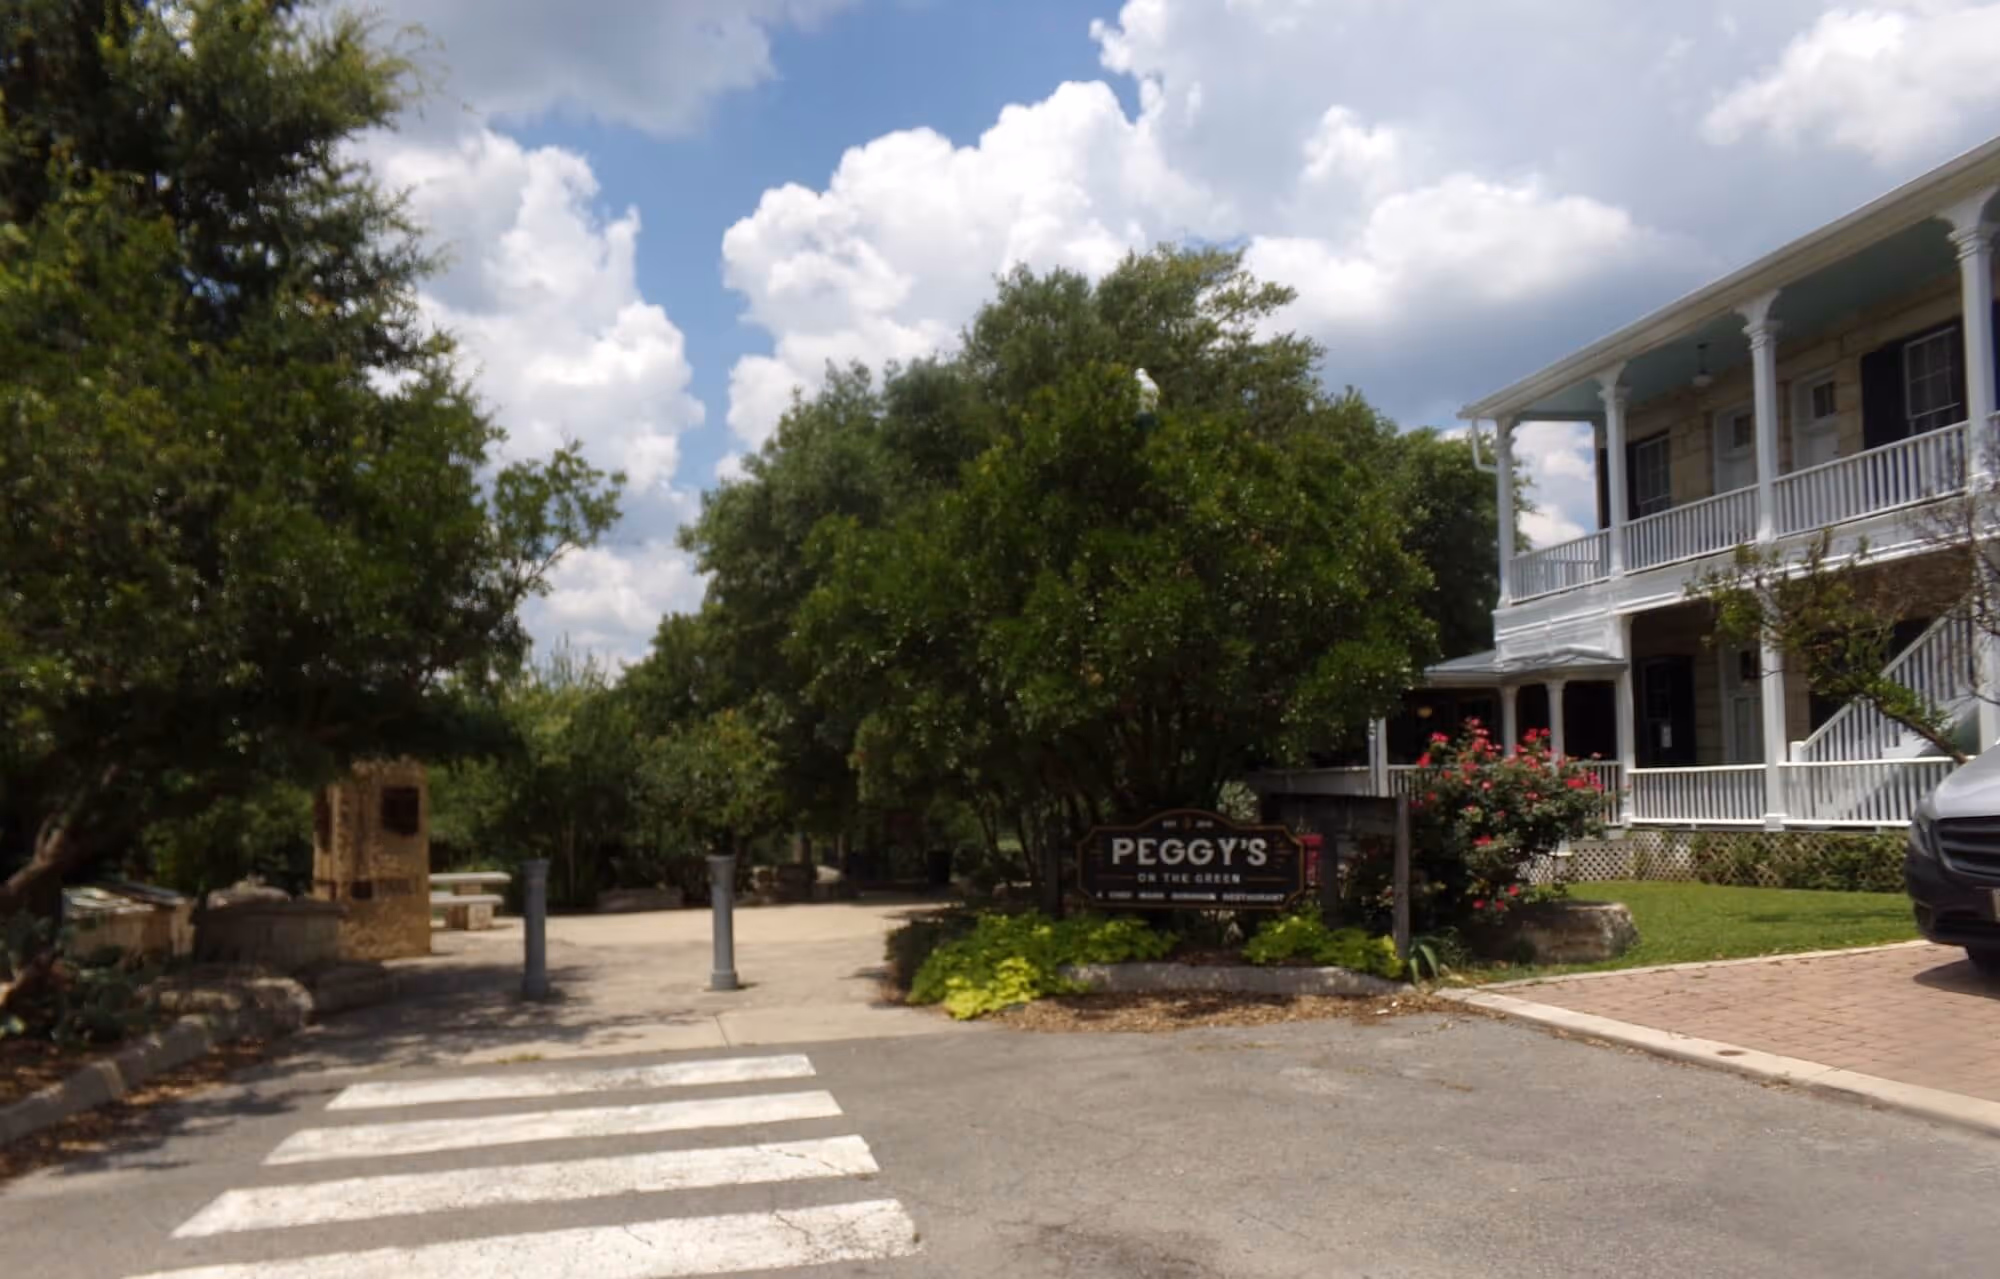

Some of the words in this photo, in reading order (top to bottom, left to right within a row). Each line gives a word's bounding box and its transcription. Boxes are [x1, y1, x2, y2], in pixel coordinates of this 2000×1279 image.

[1111, 837, 1268, 866] PEGGY'S
[1137, 873, 1156, 883] ON
[1163, 873, 1189, 884] THE
[1195, 873, 1241, 884] GREEN
